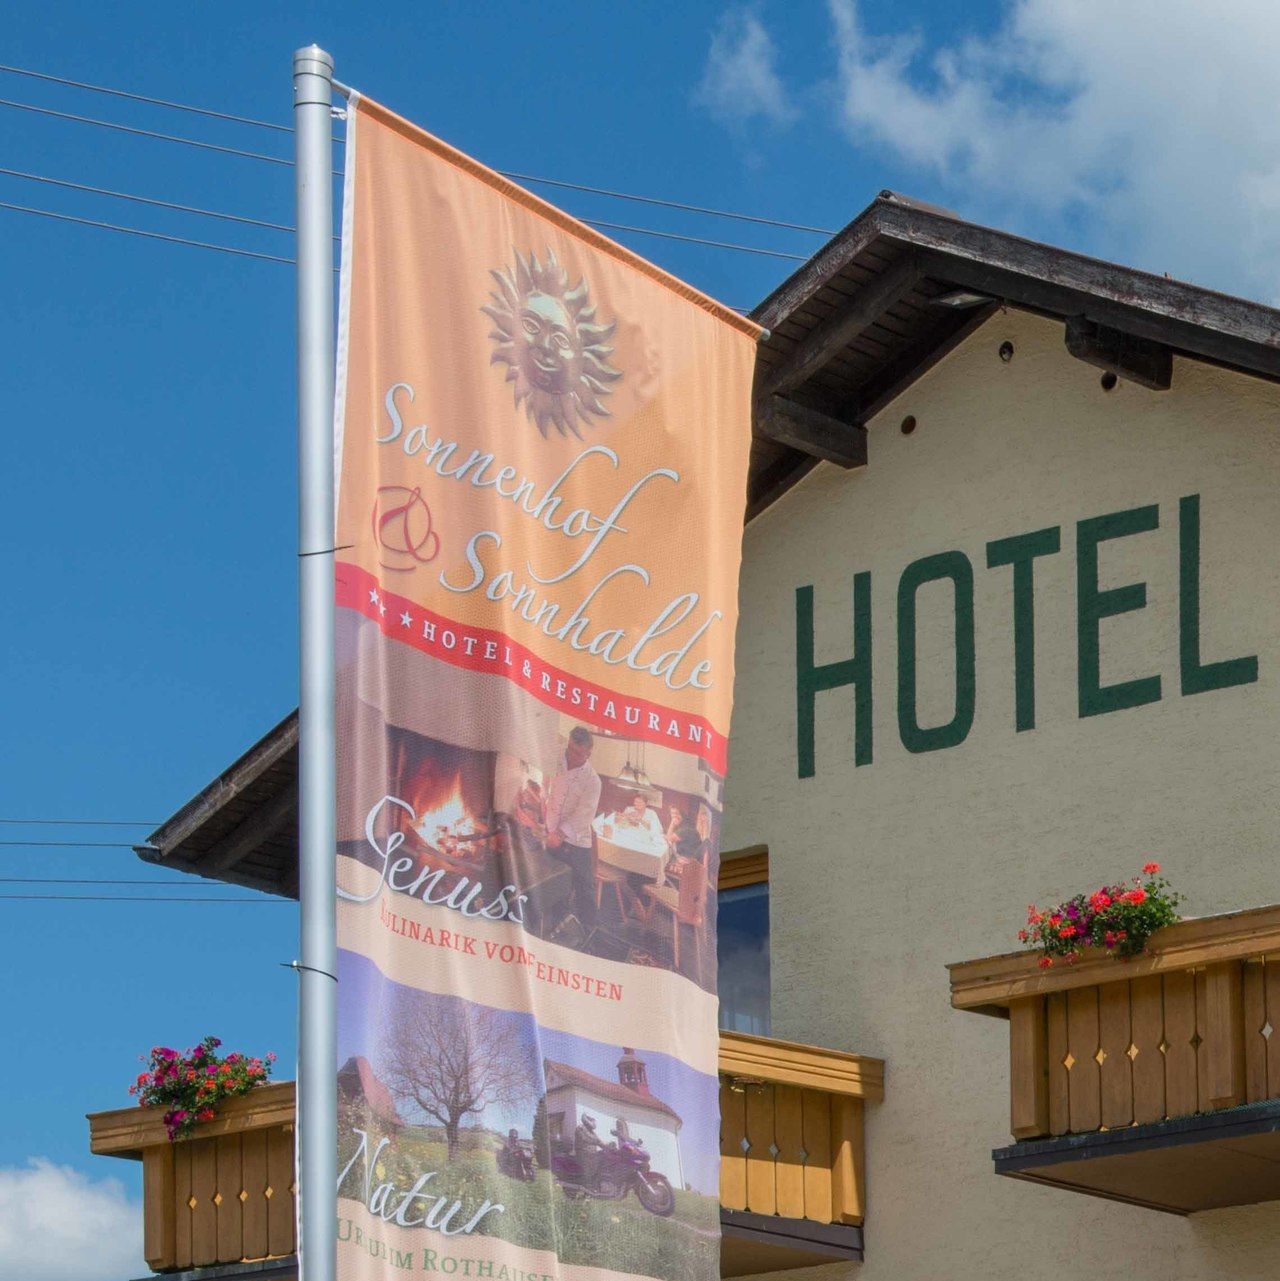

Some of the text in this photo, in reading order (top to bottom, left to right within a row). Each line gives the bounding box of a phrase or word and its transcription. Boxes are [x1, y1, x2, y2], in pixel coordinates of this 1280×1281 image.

[377, 383, 680, 582] Sonnenhof
[439, 530, 722, 689] Sonnhalde
[796, 493, 1259, 779] HOTEL
[422, 620, 714, 749] HOTEL & RESTAURANT
[336, 795, 528, 923] Genuss
[336, 1128, 505, 1235] Natur
